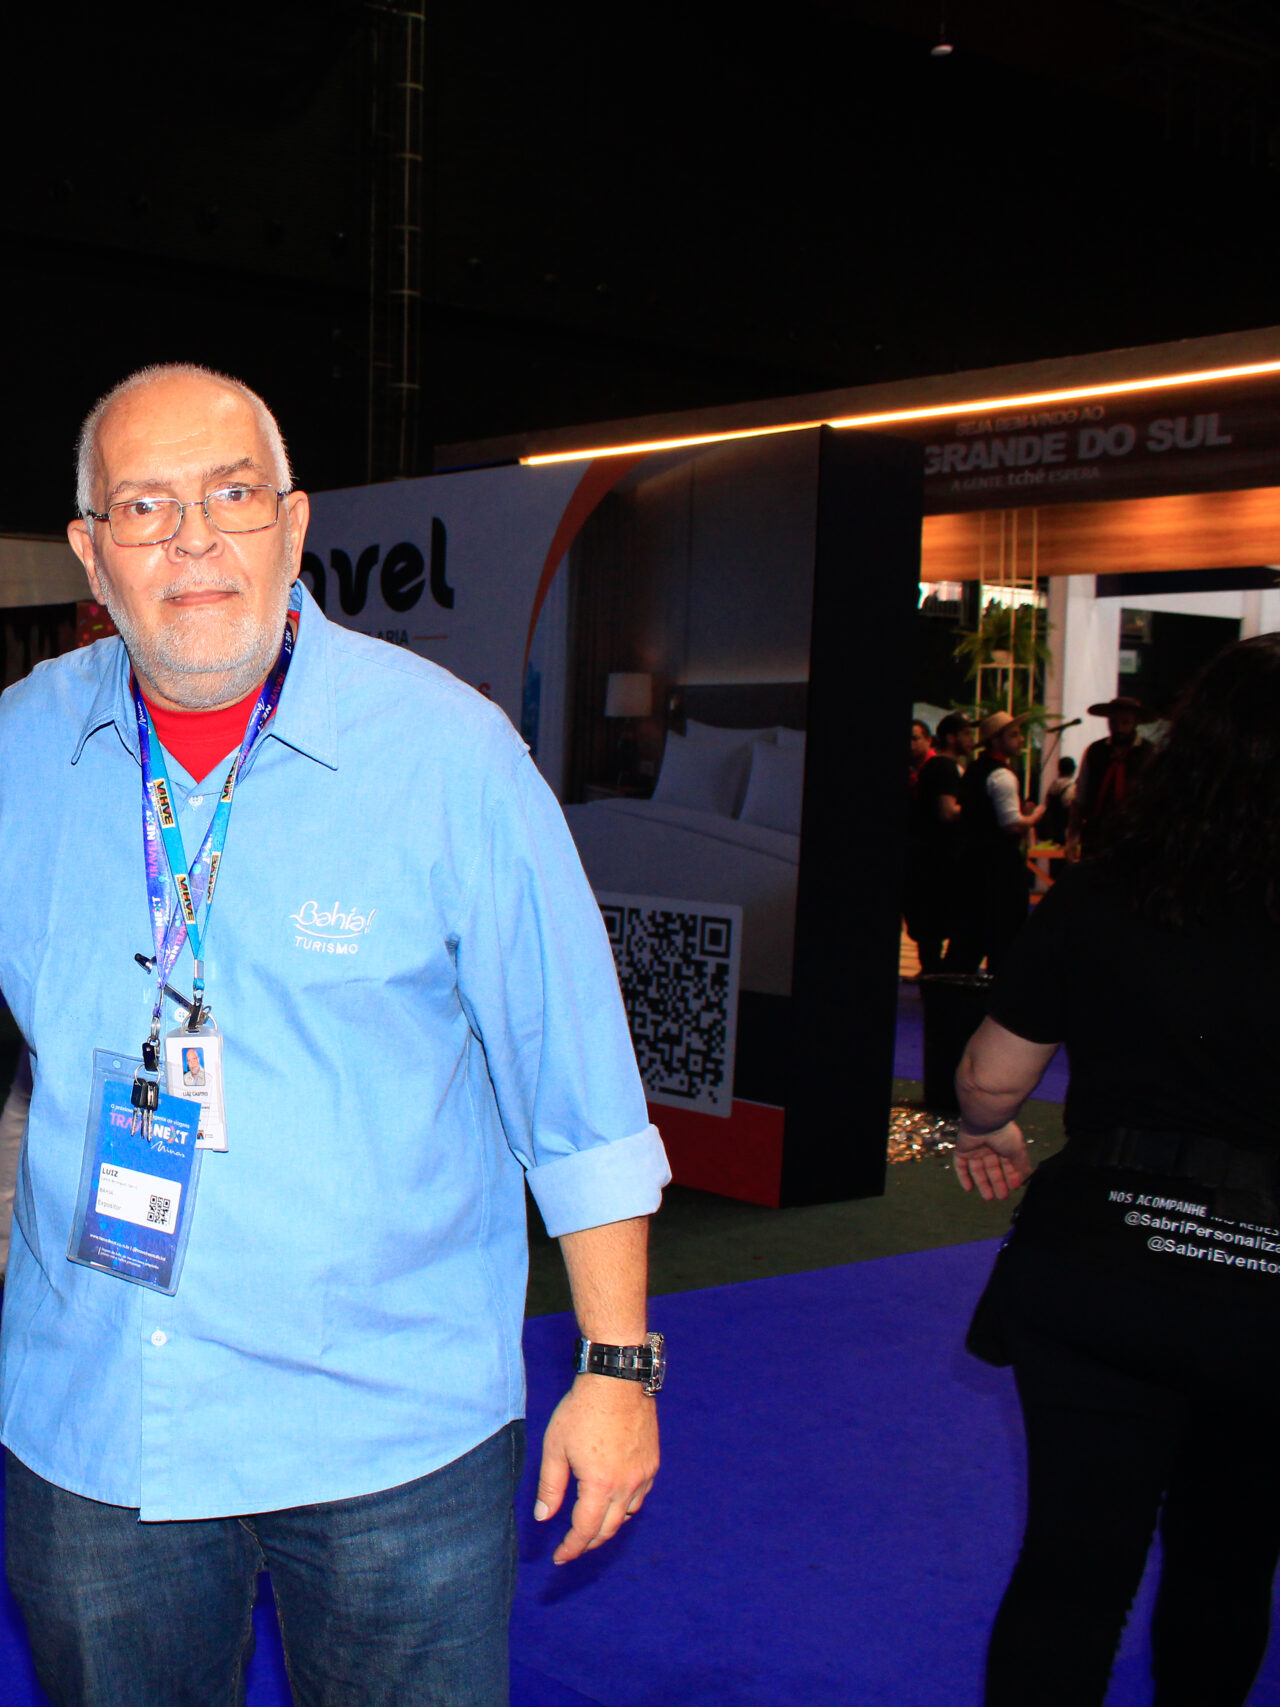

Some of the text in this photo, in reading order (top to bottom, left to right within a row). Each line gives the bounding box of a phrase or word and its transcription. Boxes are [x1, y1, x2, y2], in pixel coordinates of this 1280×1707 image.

[1079, 405, 1105, 421] AO
[1077, 423, 1136, 460] DO
[1146, 412, 1233, 453] SUL
[963, 474, 1004, 491] GENTE
[1007, 469, 1046, 488] tché
[1048, 466, 1100, 484] ESPERA
[145, 810, 159, 878] TRAVELNEXT
[295, 935, 359, 955] TURISMO
[102, 1167, 119, 1178] LUIZ
[1108, 1190, 1133, 1204] NOS
[1136, 1194, 1208, 1219] ACOMPANHE
